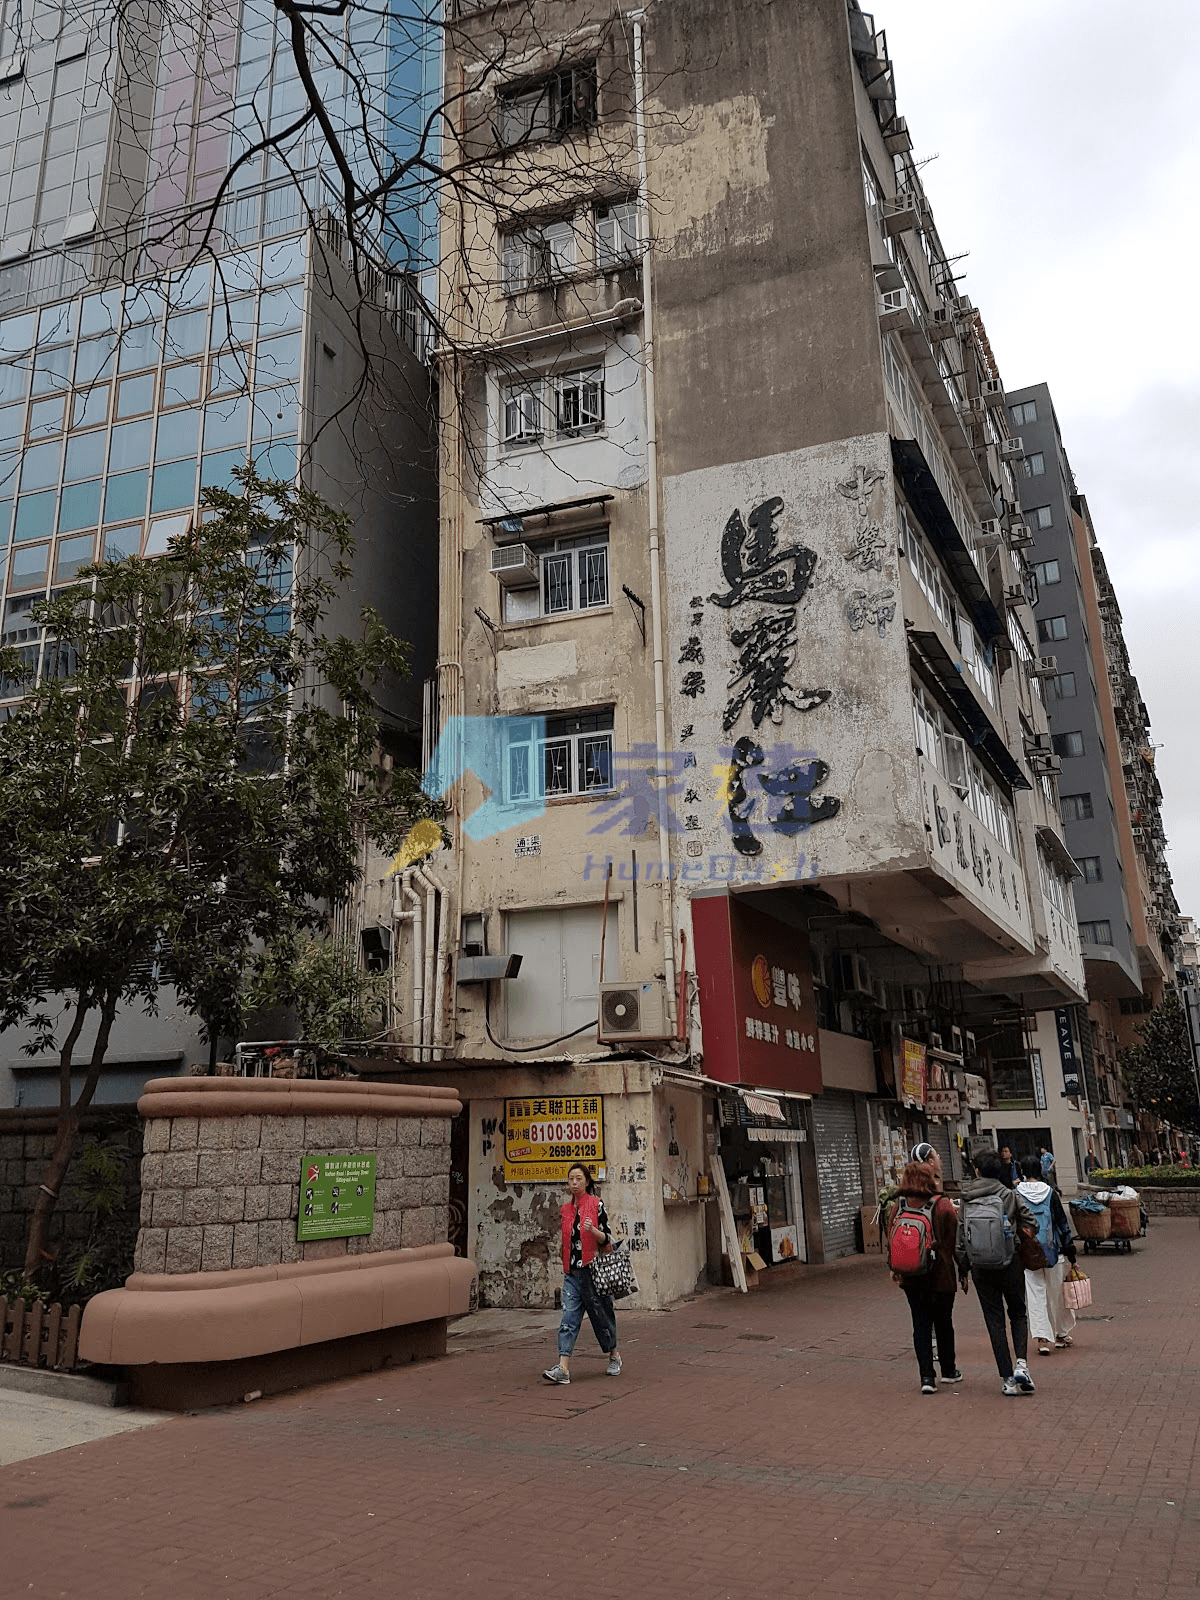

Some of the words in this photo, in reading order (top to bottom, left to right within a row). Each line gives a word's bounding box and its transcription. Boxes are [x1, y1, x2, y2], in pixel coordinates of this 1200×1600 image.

[1059, 1008, 1072, 1060] EAVE
[533, 1099, 598, 1116] 美聯旺舖
[508, 1127, 530, 1141] 張小姐
